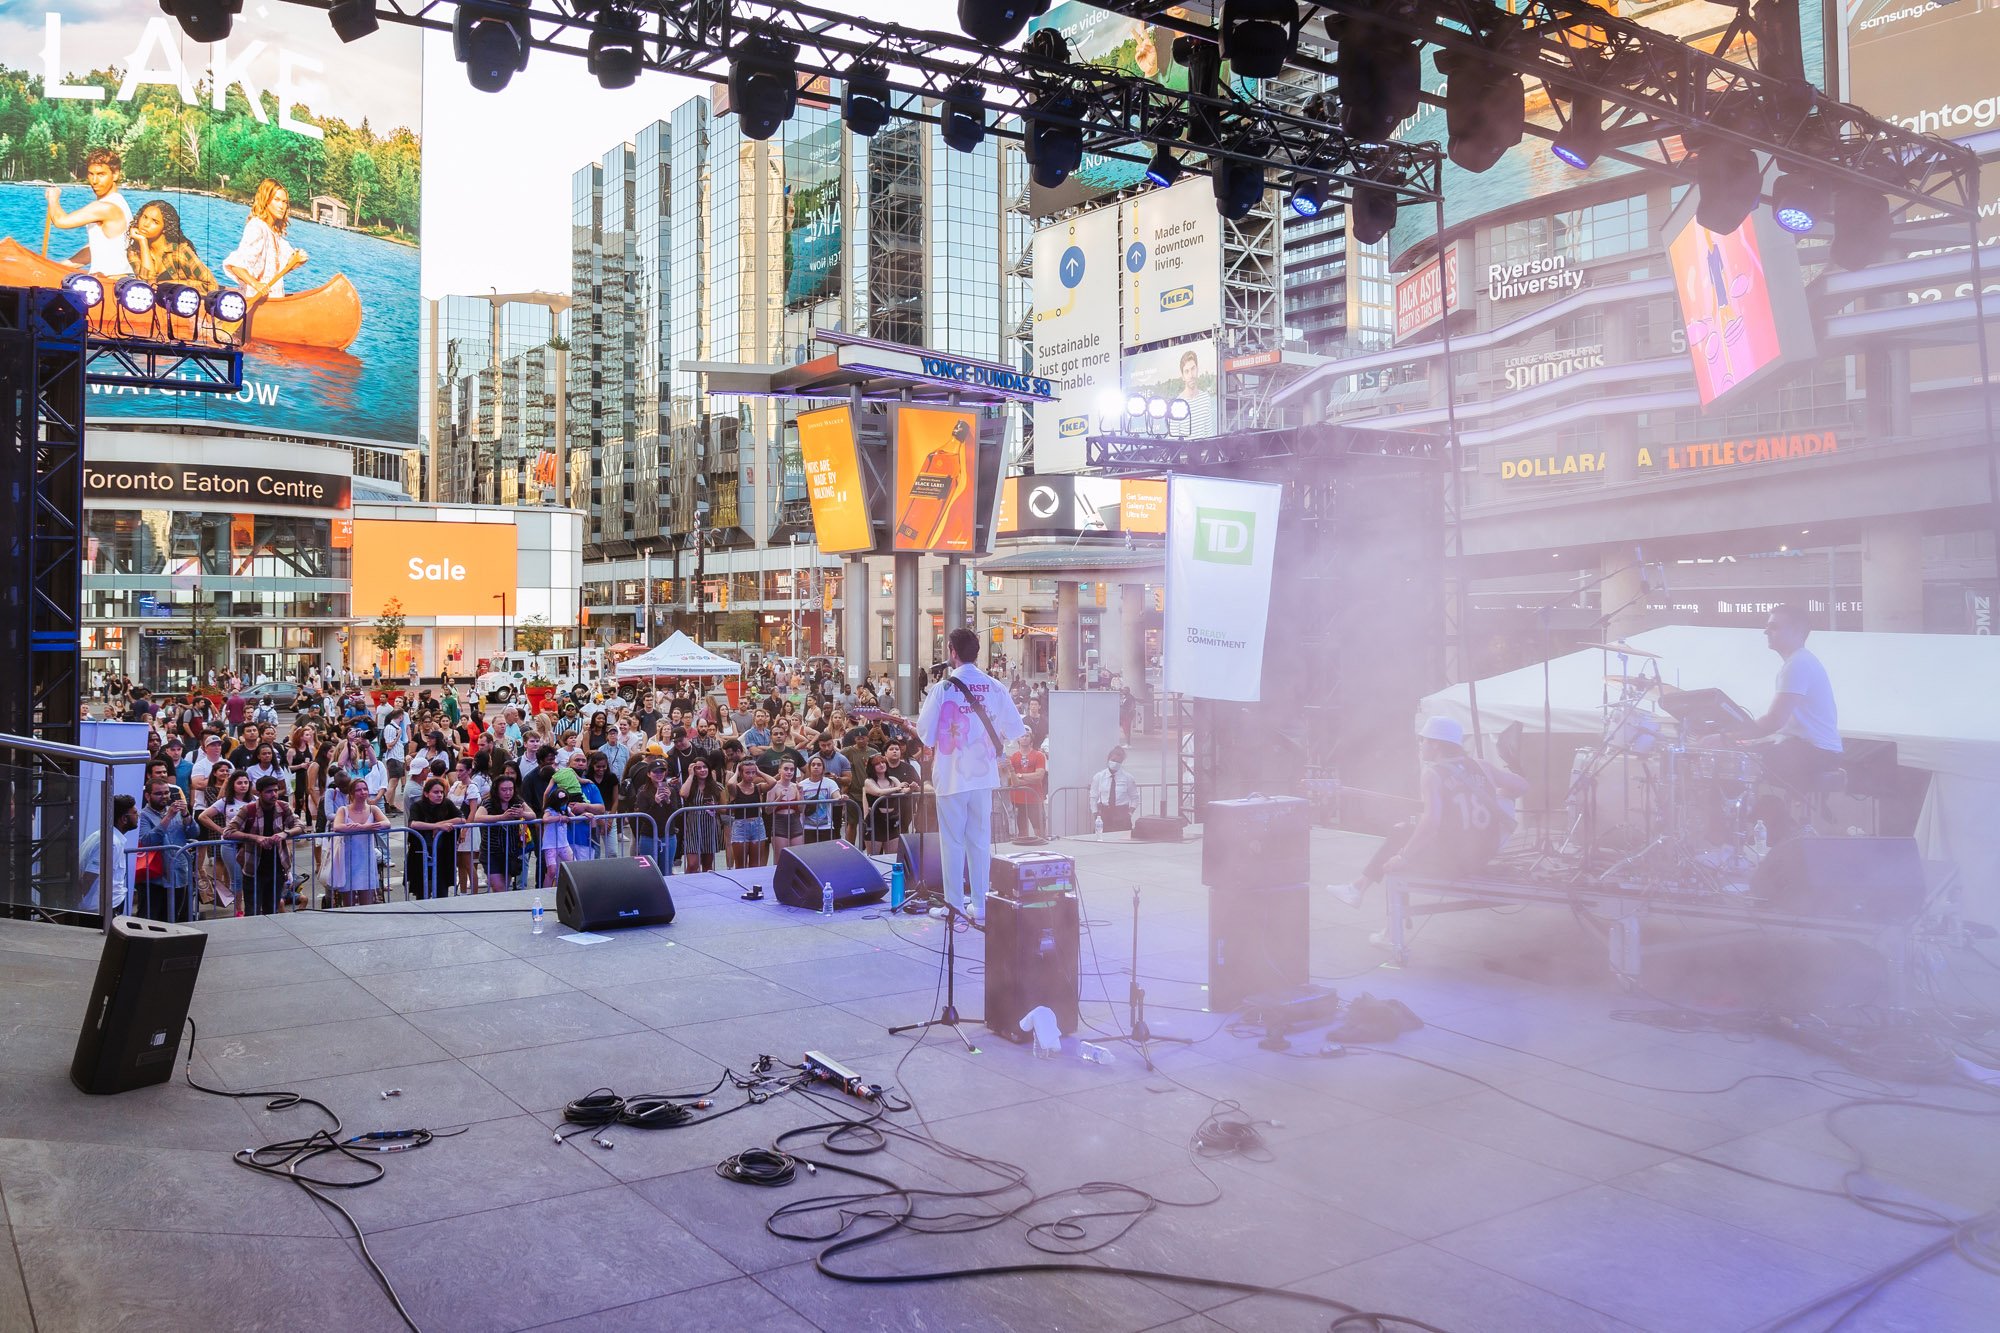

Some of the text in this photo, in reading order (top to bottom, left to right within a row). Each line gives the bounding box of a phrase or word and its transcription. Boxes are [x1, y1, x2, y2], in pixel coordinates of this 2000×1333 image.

[1079, 10, 1109, 29] video
[1860, 1, 1942, 30] samsung.co
[38, 12, 324, 140] LAKE
[1154, 219, 1197, 241] Made for
[1154, 233, 1204, 256] downtown
[1154, 257, 1184, 272] living.
[1489, 254, 1565, 283] Ryerson
[1399, 256, 1456, 315] JACK ASTO'S
[1488, 269, 1585, 301] University
[1162, 291, 1191, 306] IKEA
[1420, 301, 1433, 321] THIS
[1433, 295, 1442, 314] WA
[1039, 333, 1100, 359] Sustainable
[1039, 352, 1110, 380] just got more
[1505, 353, 1540, 367] LOUNGE
[921, 357, 1051, 396] YONGE-DUNDAS SQ
[1060, 373, 1096, 392] inable.
[1060, 420, 1087, 433] IKEA
[1736, 432, 1838, 464] CANADA
[84, 469, 324, 499] Toronto Eaton Centre
[828, 472, 837, 484] BY
[1126, 493, 1163, 503] Get Samsung
[1126, 502, 1145, 511] Galaxy
[1126, 511, 1150, 519] Ultra for
[1200, 518, 1248, 554] TD
[408, 557, 467, 581] Sale
[1735, 603, 1753, 613] THE
[1186, 636, 1247, 649] COMMITMENT
[1187, 627, 1227, 639] TD READY
